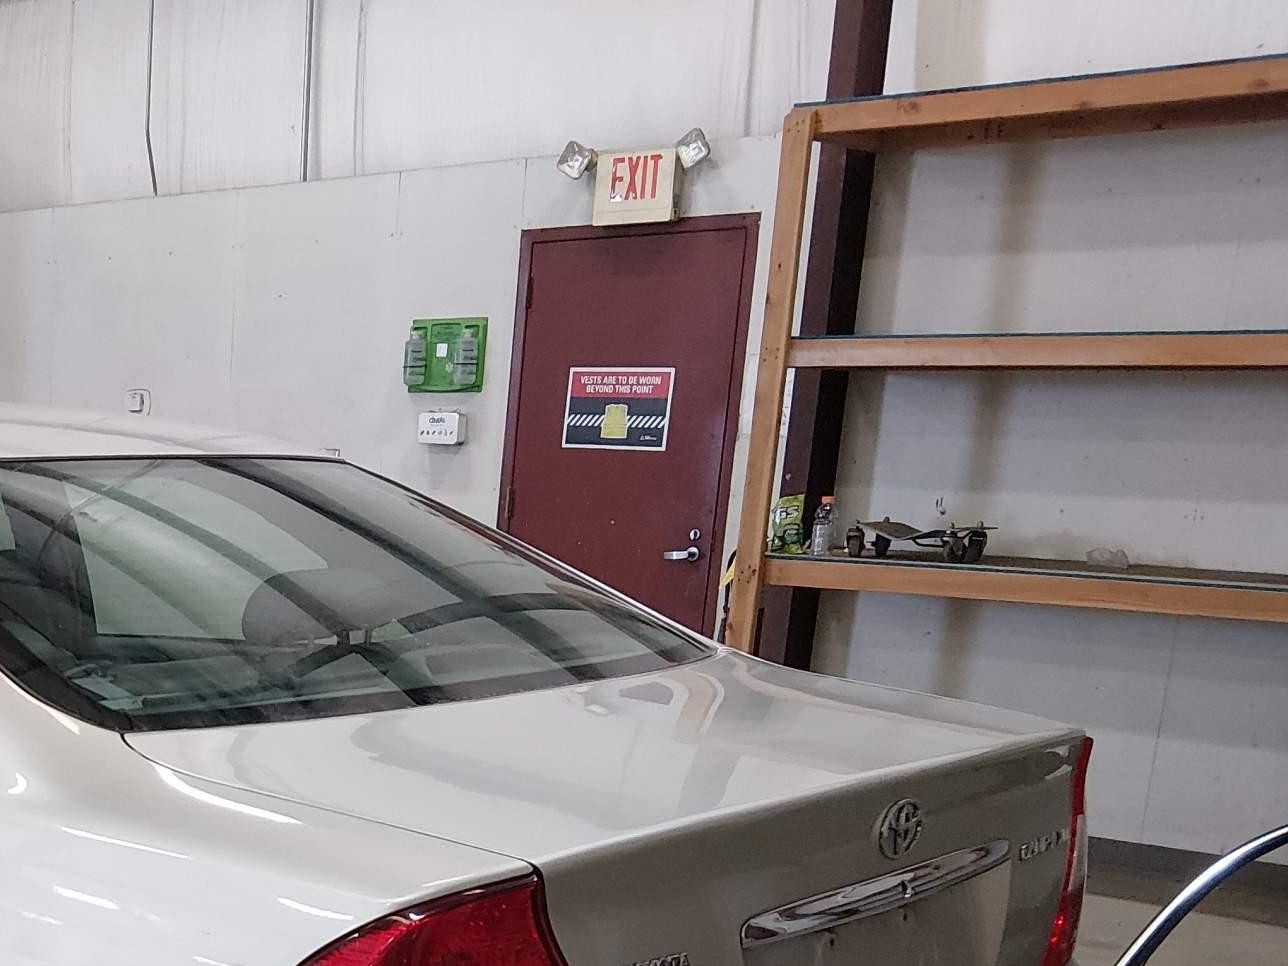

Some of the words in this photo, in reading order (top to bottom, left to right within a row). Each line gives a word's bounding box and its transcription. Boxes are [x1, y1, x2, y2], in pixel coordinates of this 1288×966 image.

[610, 153, 663, 200] EXIT
[580, 376, 601, 385] VESTS
[603, 376, 617, 385] ARE
[618, 376, 628, 385] TO
[639, 376, 662, 385] WORN
[586, 385, 613, 393] BEYOND
[615, 386, 631, 394] THIS
[632, 386, 654, 394] POINT
